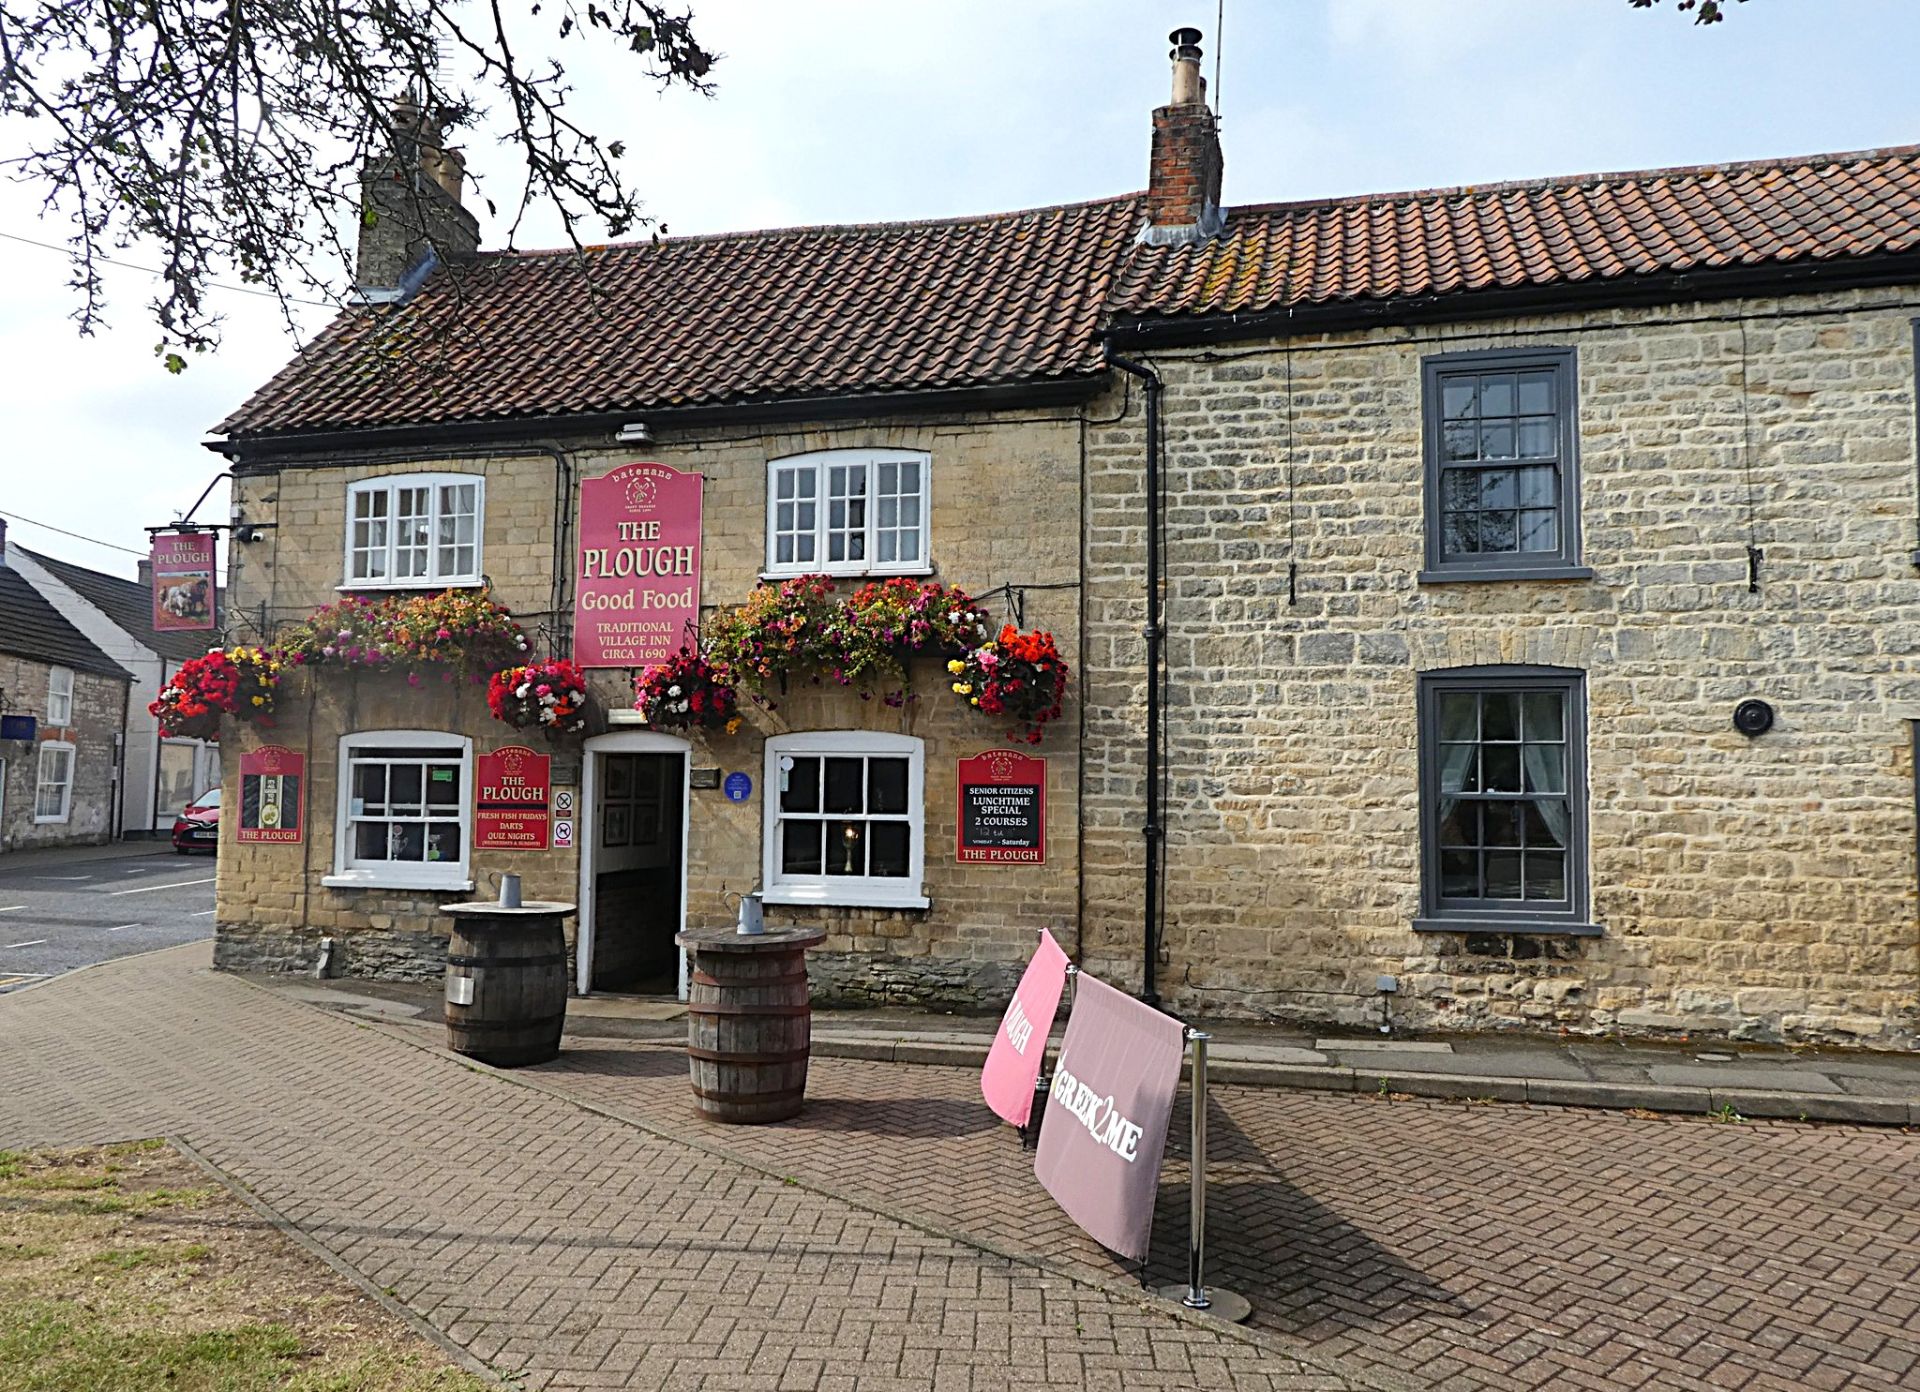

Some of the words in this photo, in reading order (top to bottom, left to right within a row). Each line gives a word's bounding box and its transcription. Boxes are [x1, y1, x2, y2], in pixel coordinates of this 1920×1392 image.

[612, 468, 672, 482] batemans
[618, 521, 661, 540] THE
[172, 542, 195, 551] THE
[157, 552, 210, 564] PLOUGH
[583, 546, 694, 577] PLOUGH
[582, 588, 634, 611] Good
[643, 587, 693, 609] Food
[597, 622, 674, 633] TRADITIONAL
[599, 636, 646, 646] VILLAGE
[650, 635, 671, 645] INN
[602, 649, 635, 659] CIRCA
[640, 648, 666, 658] 1690
[501, 777, 525, 786] THE
[483, 787, 543, 800] PLOUGH
[970, 787, 998, 795] SENIOR
[973, 797, 1030, 806] LUNCHTIME
[981, 806, 1021, 814] SPECIAL
[975, 817, 981, 826] 2
[983, 817, 1028, 826] COURSES
[242, 831, 258, 839] THE
[261, 832, 297, 840] PLOUGH
[487, 832, 506, 840] QUIZ
[1001, 838, 1030, 847] Saturday
[963, 849, 986, 859] THE
[990, 850, 1038, 860] PLOUGH
